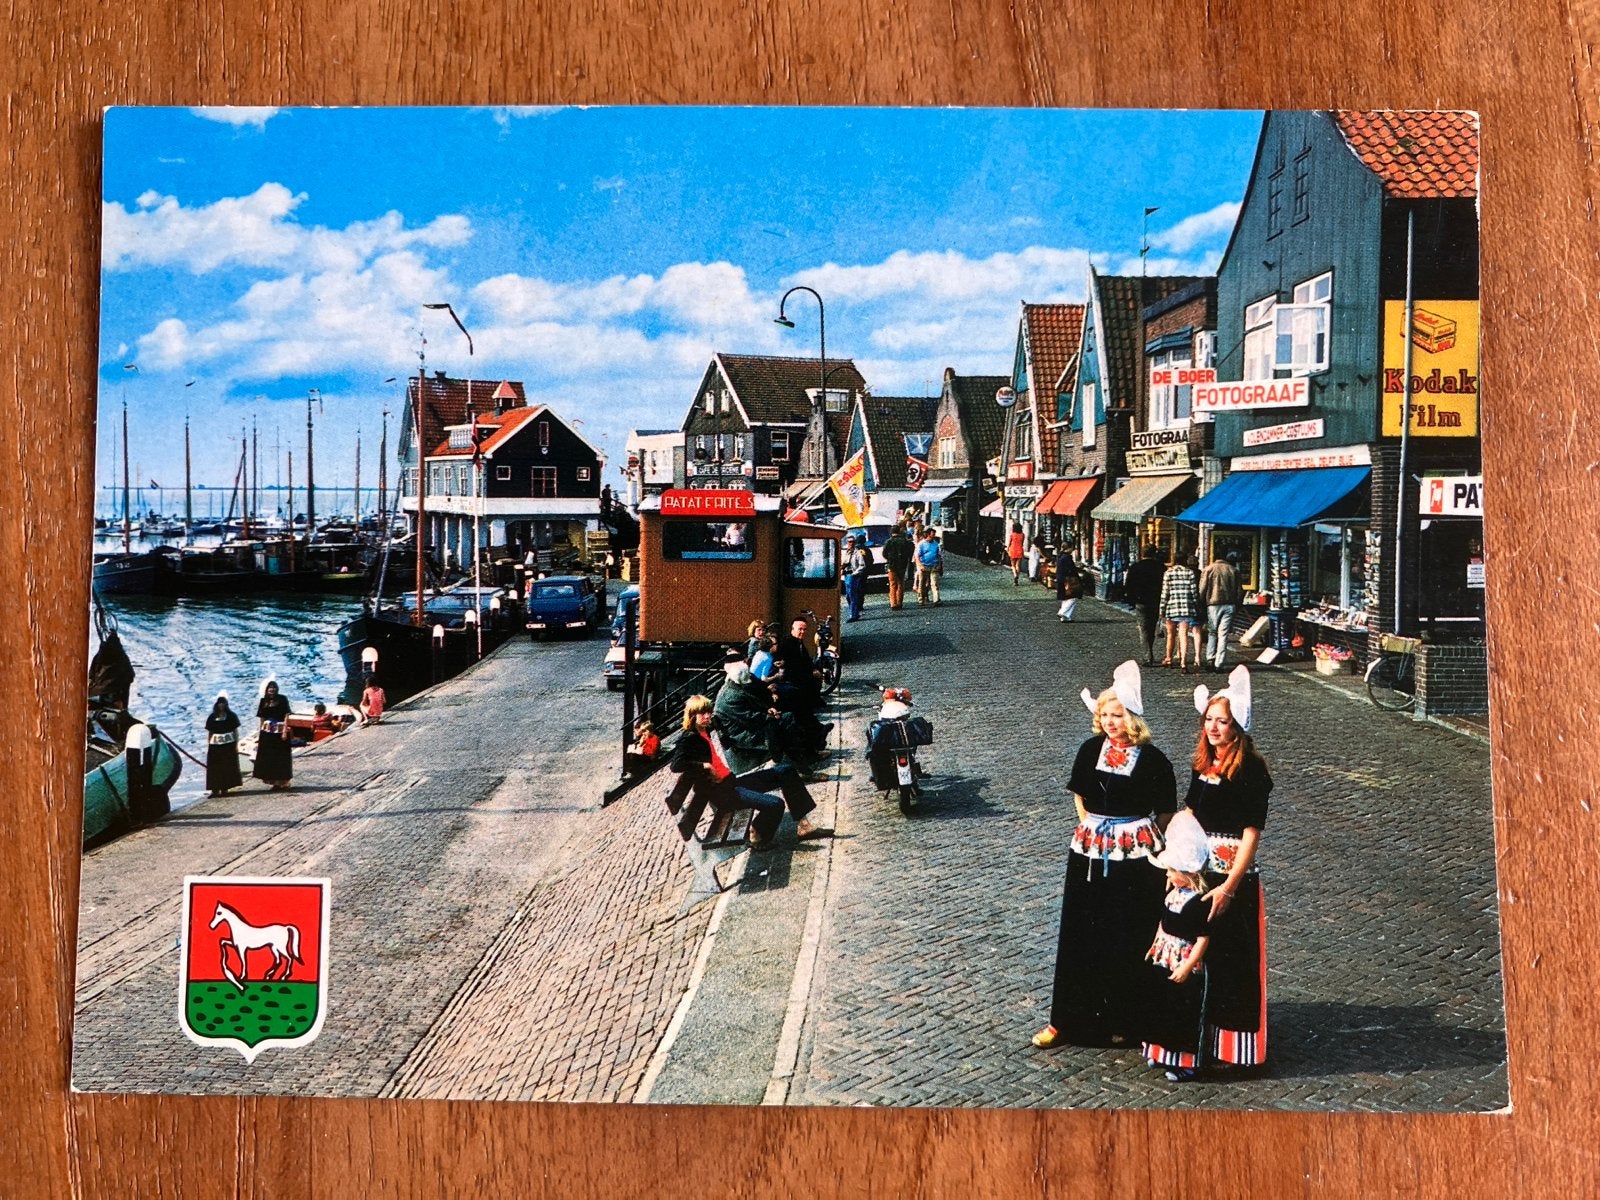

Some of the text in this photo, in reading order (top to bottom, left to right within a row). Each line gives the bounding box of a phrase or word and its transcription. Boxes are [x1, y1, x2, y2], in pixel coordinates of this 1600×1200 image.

[1152, 369, 1215, 385] DE BOER
[1384, 368, 1477, 394] Kodak
[1196, 382, 1305, 407] FOTOGRAAF
